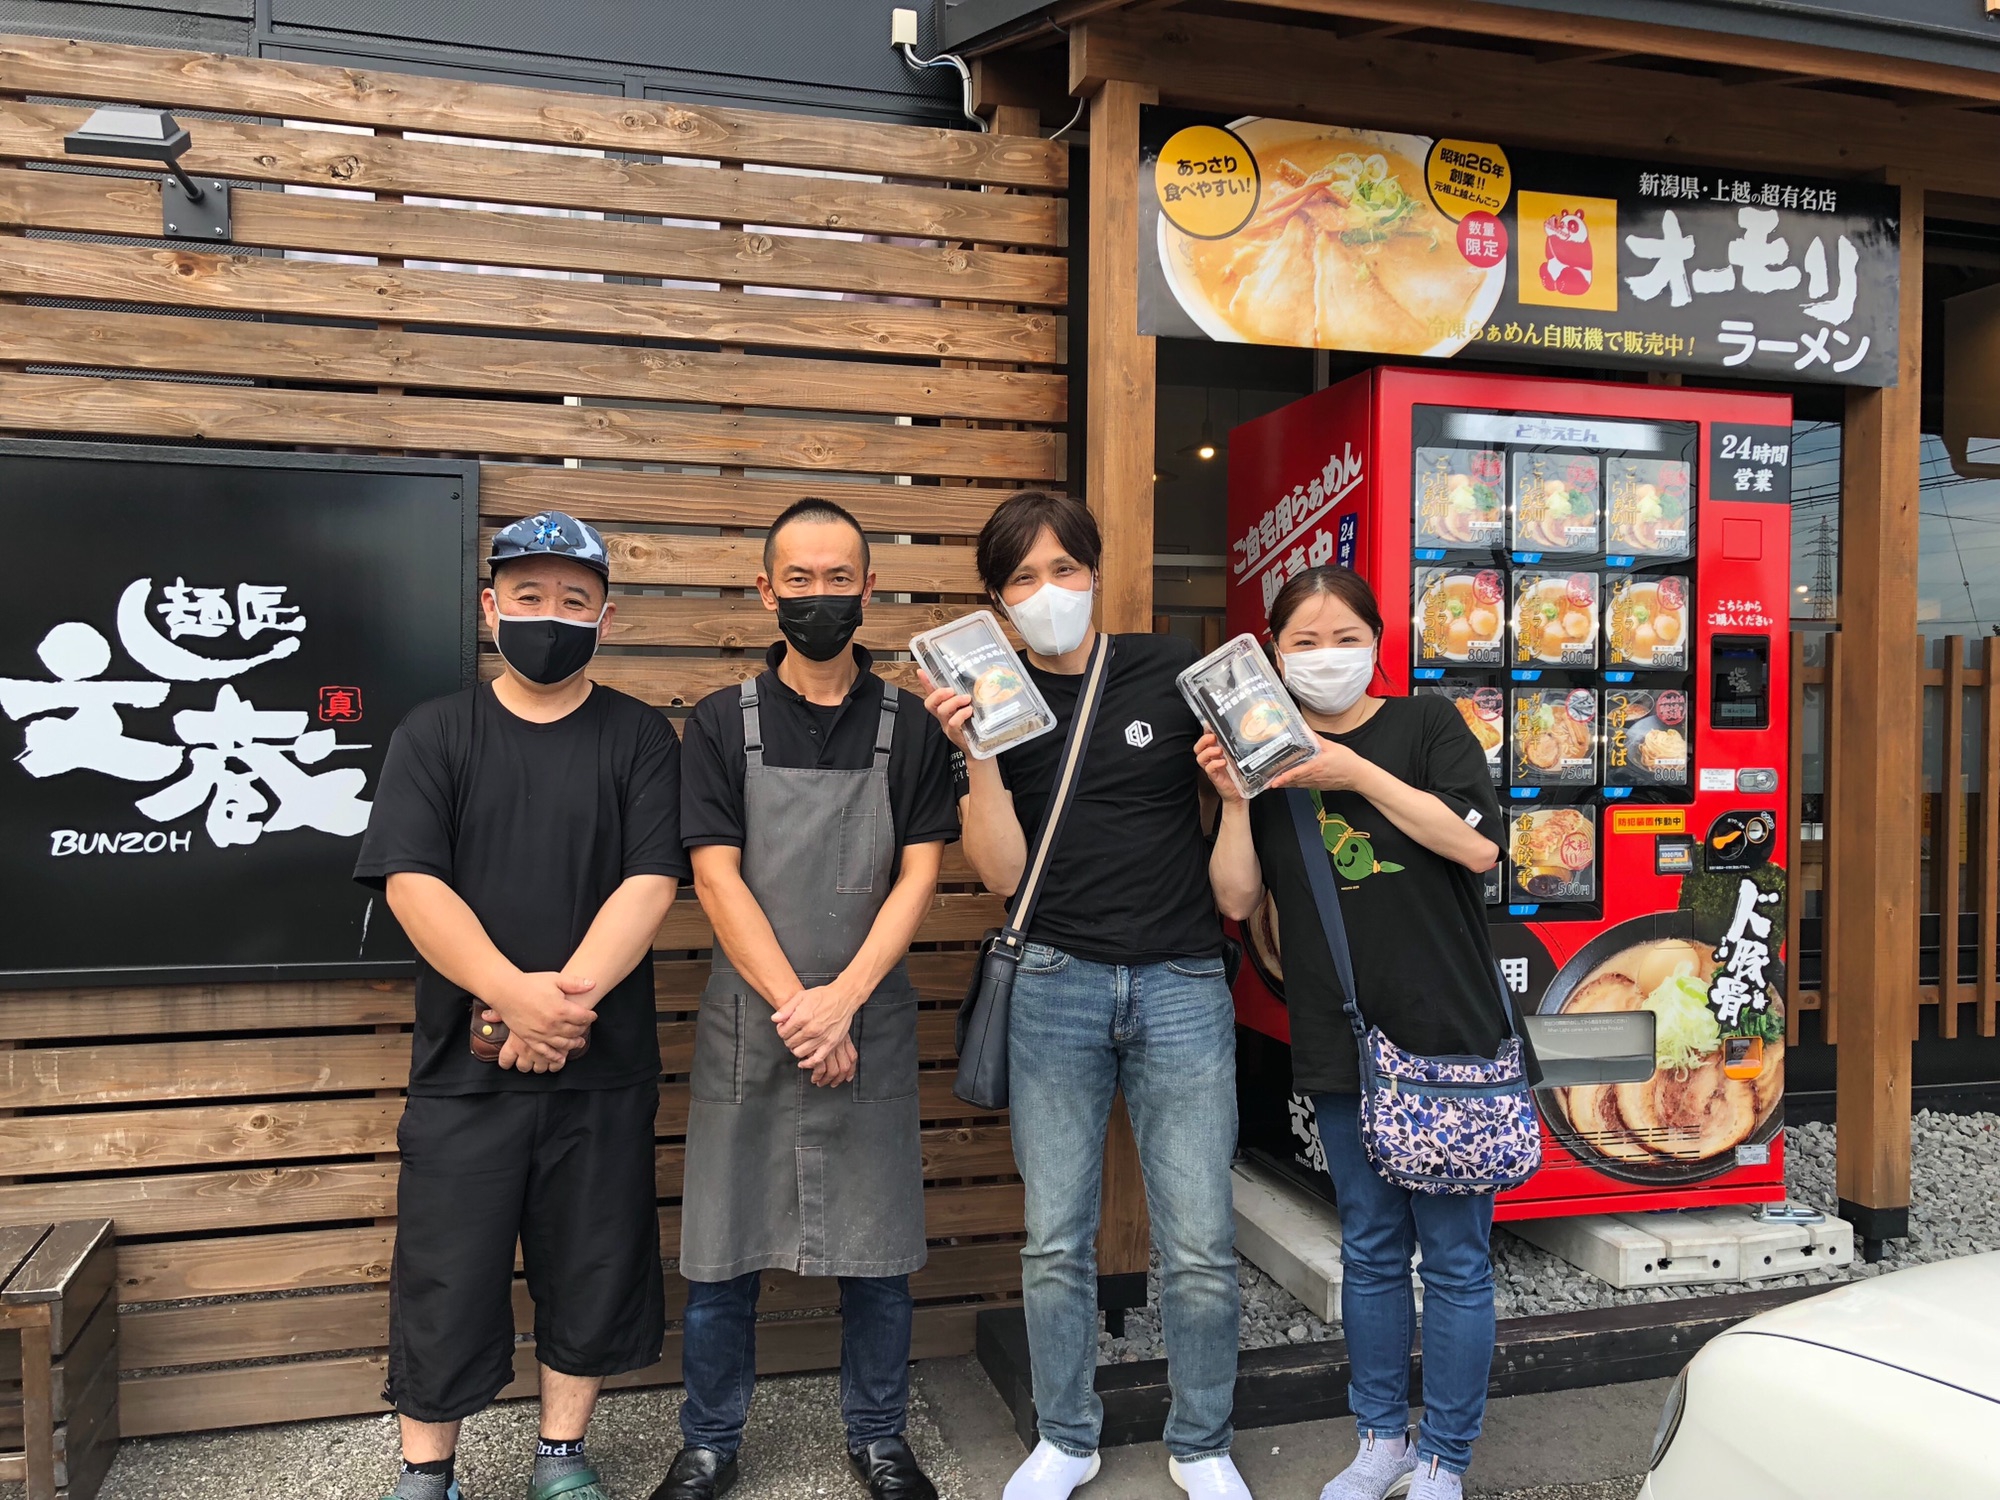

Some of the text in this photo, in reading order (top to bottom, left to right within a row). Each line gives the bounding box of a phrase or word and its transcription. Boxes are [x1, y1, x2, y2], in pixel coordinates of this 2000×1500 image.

[1177, 154, 1238, 177] あっさり
[1440, 147, 1505, 179] 昭和26年
[1164, 178, 1251, 203] 食べやすい!
[1450, 168, 1486, 191] 創業!!
[1434, 181, 1500, 208] 元祖上越とんこつ
[1639, 172, 1838, 213] 新潟県・上越の超有名店
[1468, 220, 1495, 238] 数量
[1465, 239, 1499, 258] 限定
[1624, 206, 1860, 326] オーモリ
[1426, 315, 1696, 358] 冷凍らぁめん自販機で販売中!
[1718, 319, 1871, 374] ラーメン
[1719, 434, 1789, 467] 24時間
[1732, 467, 1774, 493] 営業
[1232, 441, 1363, 576] ご自宅用らぁめん
[1421, 471, 1436, 535] らぁめん
[1518, 477, 1533, 539] らぁめん
[1611, 480, 1624, 542] らぁめん
[1425, 550, 1436, 559] 01
[1522, 553, 1533, 563] 02
[1616, 556, 1626, 566] 03
[156, 576, 307, 641] 麺匠
[1423, 575, 1436, 660] とんこつ醤油
[1716, 600, 1763, 614] こちらから
[1518, 578, 1531, 662] とんこつ醤油
[1611, 581, 1623, 664] とんこつ醤油
[1707, 613, 1774, 628] ご購入ください
[1467, 648, 1500, 663] 800円
[1561, 650, 1593, 664] 800円
[1652, 652, 1683, 667] 800円
[1425, 669, 1435, 679] 04
[1522, 671, 1532, 680] 05
[1615, 672, 1625, 681] 06
[324, 689, 357, 719] 真
[1517, 697, 1530, 779] 豚骨ラーメン
[1611, 695, 1629, 767] つけそば
[1560, 765, 1592, 780] 750円
[1654, 767, 1685, 781] 800円
[1617, 816, 1682, 828] 防犯装置作動中
[50, 830, 192, 857] BUNZOH
[1516, 812, 1535, 888] 金の餃子
[1564, 839, 1591, 852] 大粒
[1557, 881, 1590, 896] 500円
[1519, 905, 1529, 914] 11
